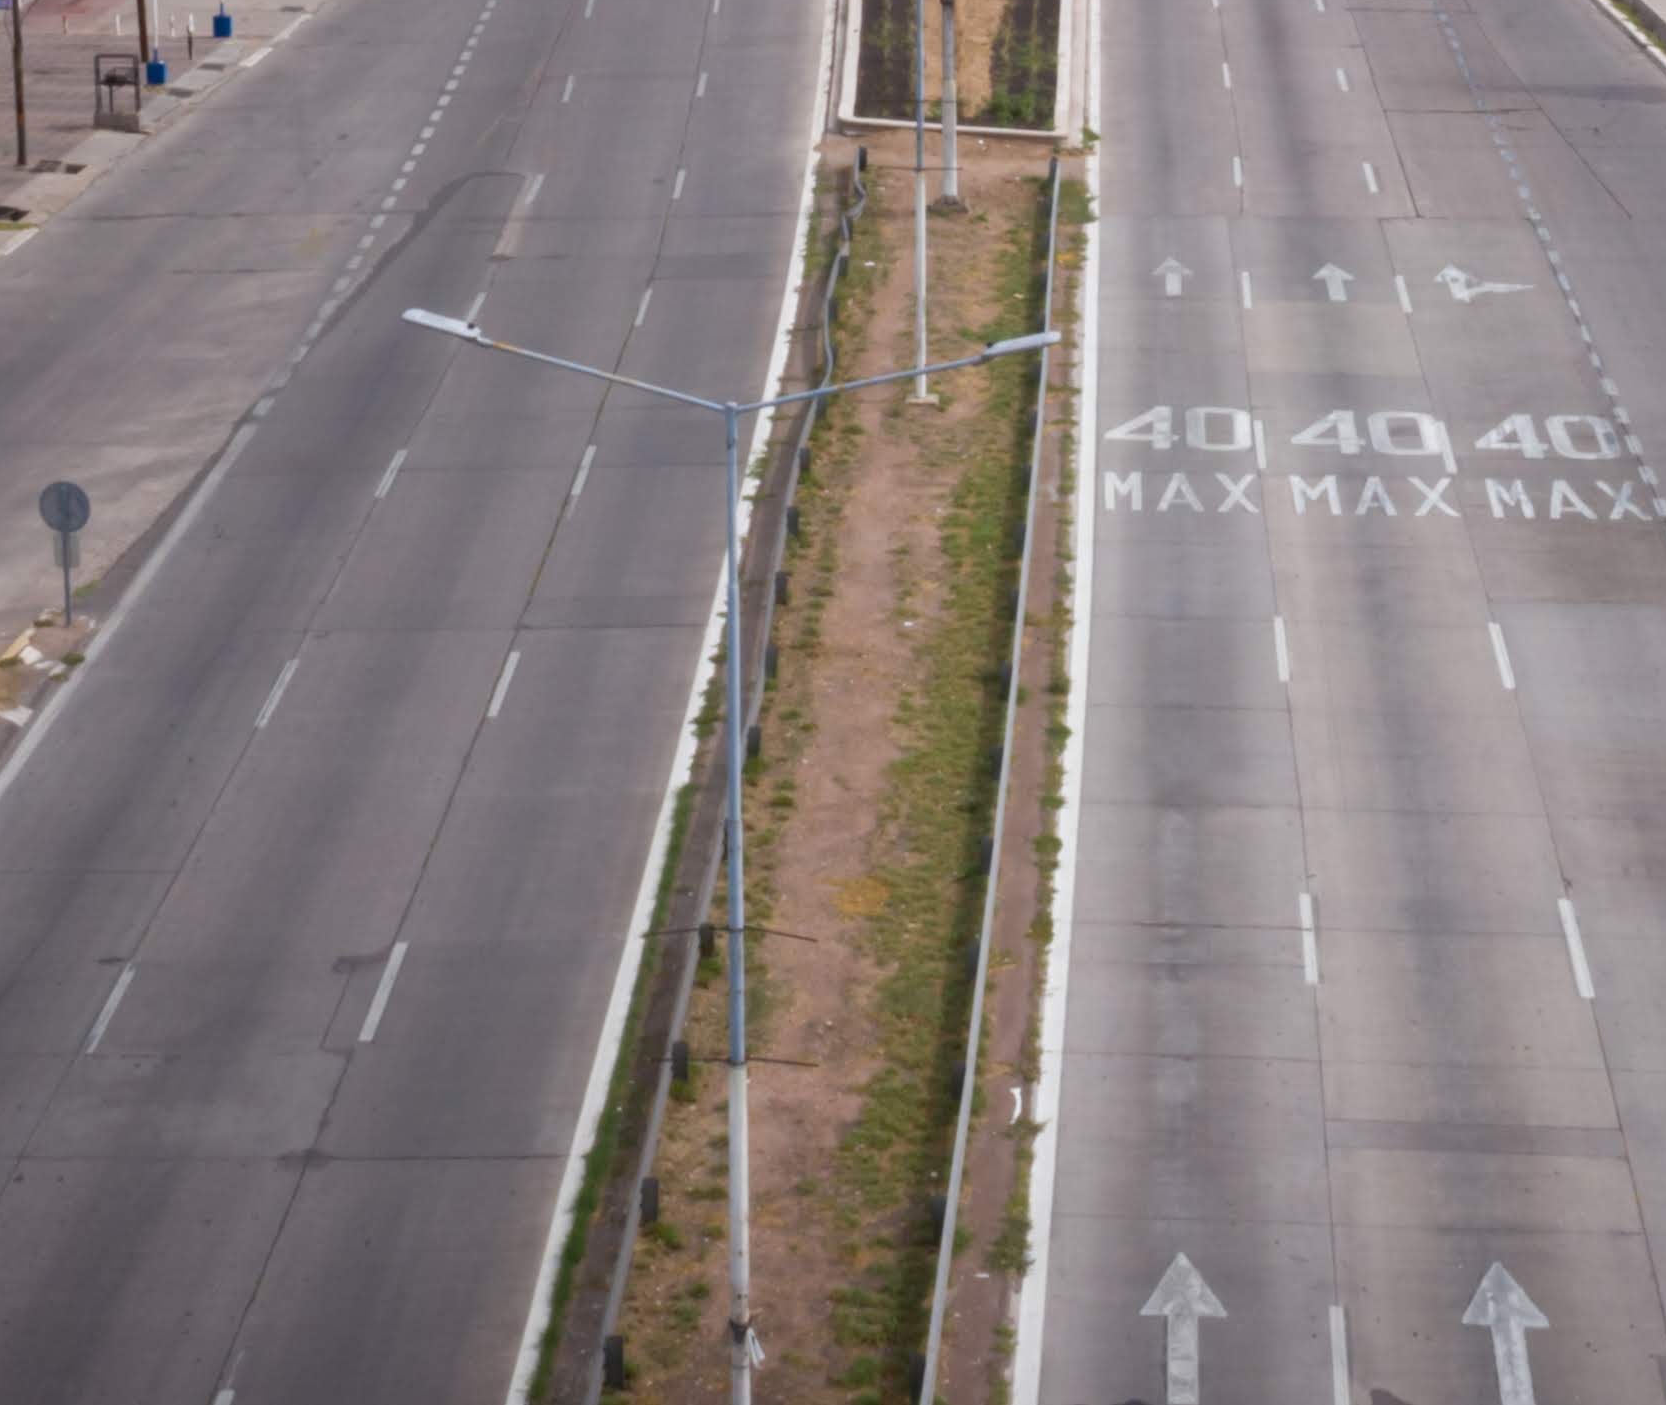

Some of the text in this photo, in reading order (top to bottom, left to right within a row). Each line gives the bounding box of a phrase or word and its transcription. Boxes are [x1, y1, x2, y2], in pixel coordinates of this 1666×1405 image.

[1103, 405, 1252, 453] 40
[1291, 409, 1444, 456] 40
[1474, 413, 1621, 461] 40
[1103, 471, 1259, 514] MAX
[1288, 473, 1460, 518] MAX
[1485, 478, 1653, 522] MAX
